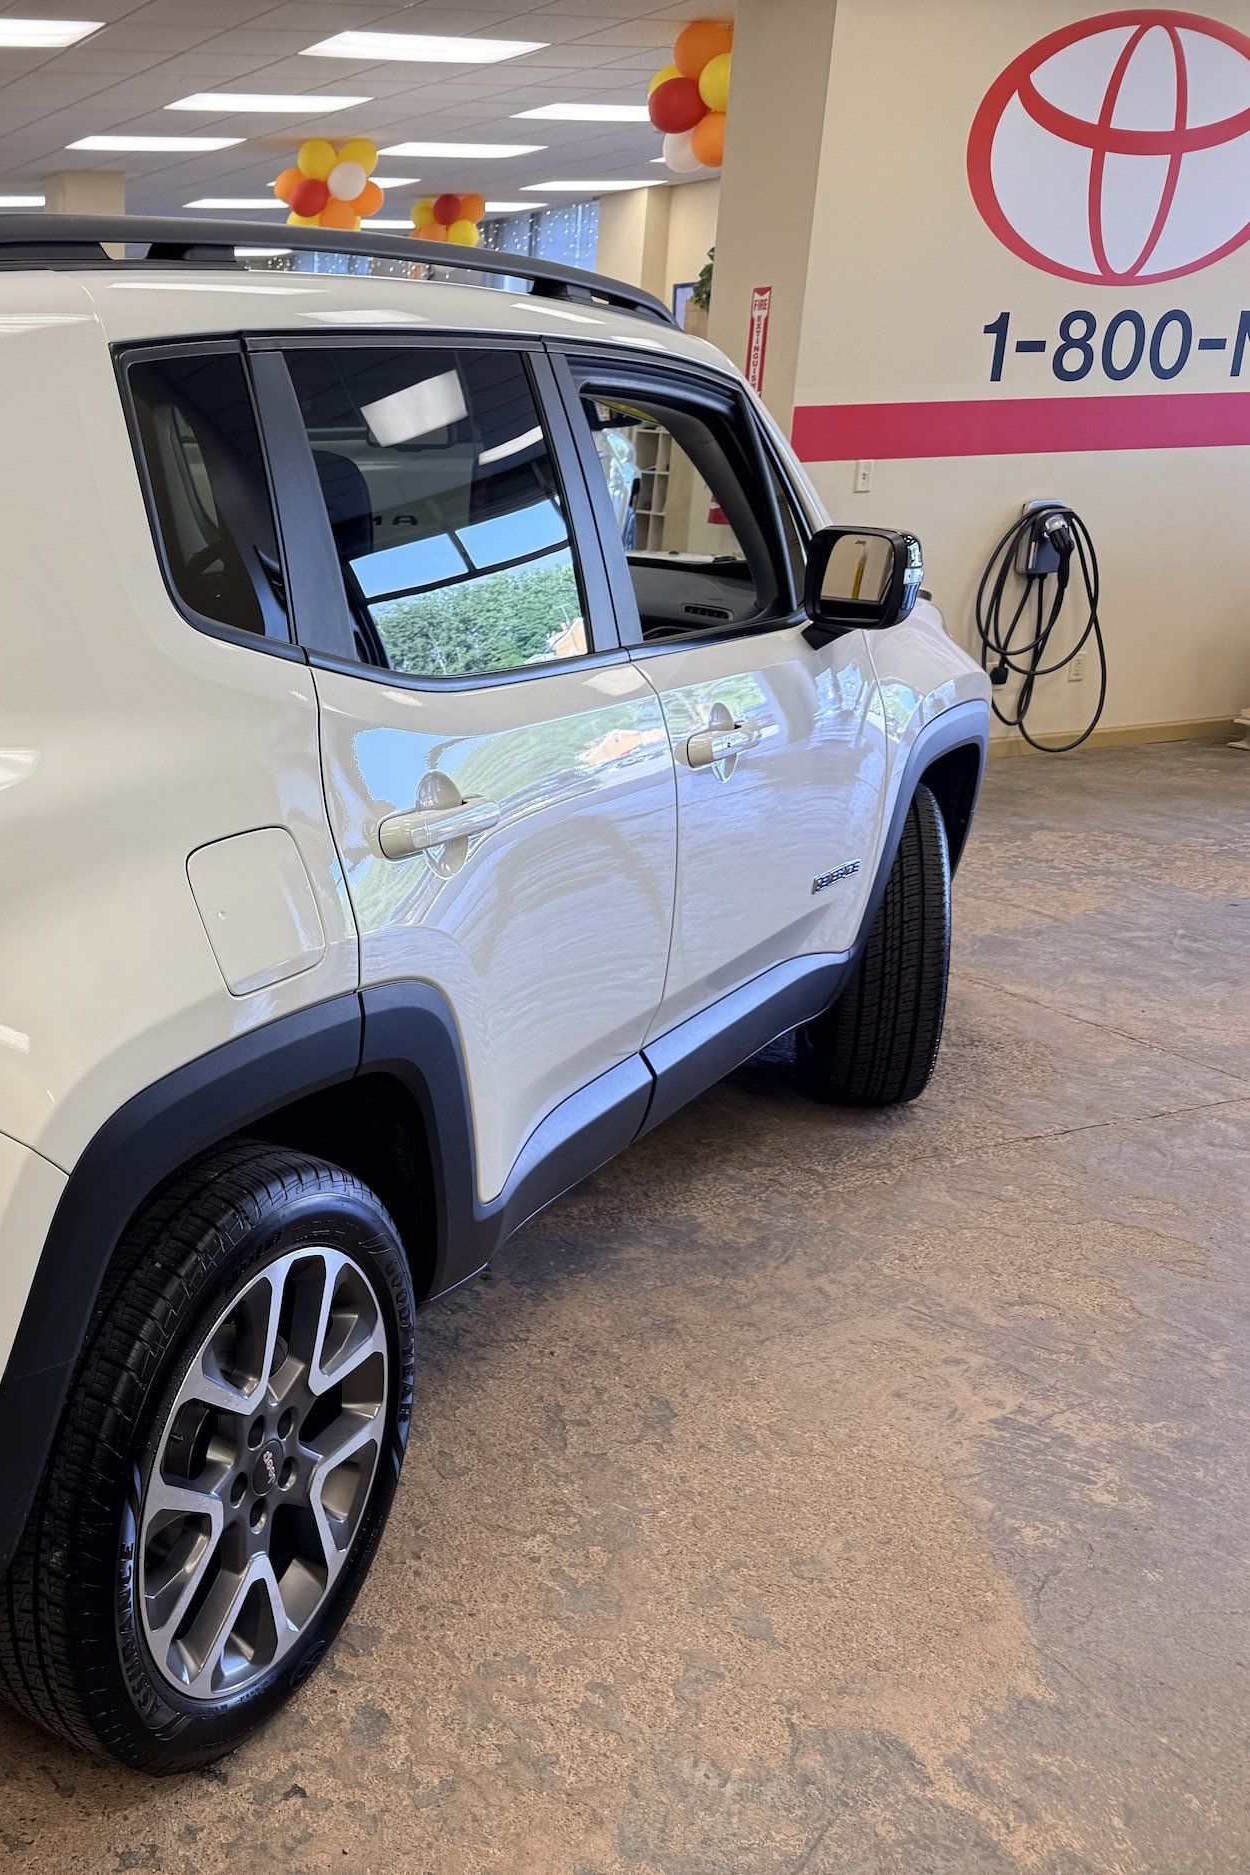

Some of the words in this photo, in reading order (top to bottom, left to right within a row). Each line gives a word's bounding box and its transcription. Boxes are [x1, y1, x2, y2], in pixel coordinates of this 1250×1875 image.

[815, 860, 860, 891] RENEGADE
[385, 1259, 414, 1423] GOODYEAR
[262, 1450, 276, 1484] Jeep
[117, 1542, 162, 1718] ASSURANCE
